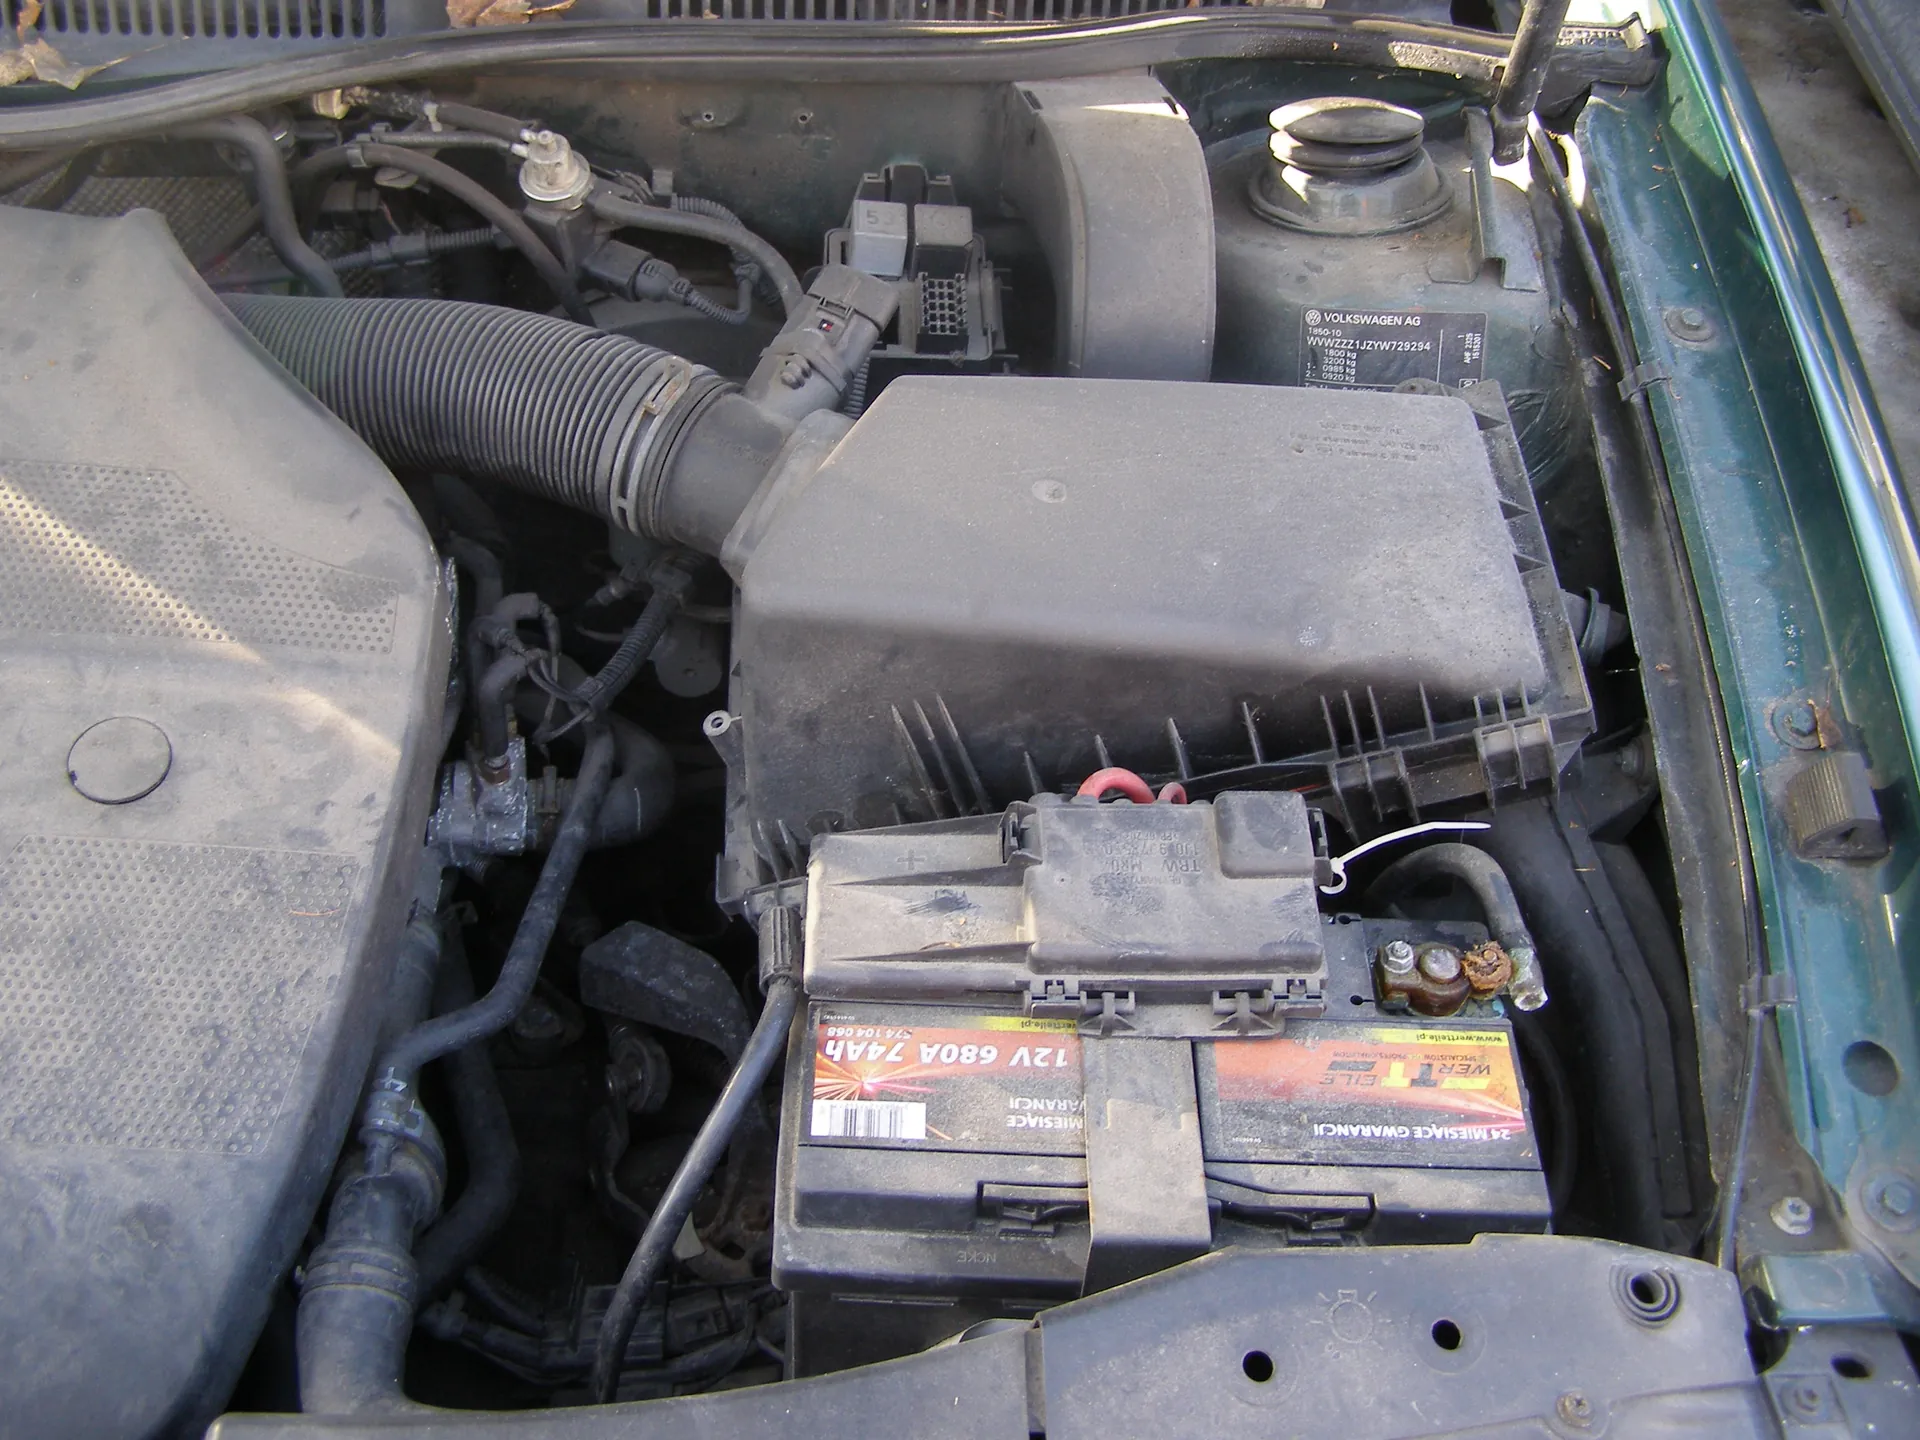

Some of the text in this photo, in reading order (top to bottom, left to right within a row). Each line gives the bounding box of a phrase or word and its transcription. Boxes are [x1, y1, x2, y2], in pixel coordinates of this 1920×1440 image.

[1324, 312, 1403, 326] VOLKSWAGEN
[1404, 315, 1421, 327] AG
[1308, 327, 1342, 337] 1850-10
[1307, 336, 1431, 352] WVWZZZ1JZYW729294
[1325, 349, 1357, 360] 1800 kg
[1323, 357, 1356, 367] 3200 kg
[1322, 365, 1344, 373] 0985
[1346, 366, 1356, 375] kg
[1322, 373, 1344, 381] 0920
[1346, 374, 1355, 383] kg
[1160, 859, 1201, 873] TRW
[827, 1026, 852, 1038] 068
[857, 1027, 881, 1039] 104
[1416, 1033, 1503, 1043] www.wertteile.pl
[825, 1039, 1068, 1068] 12V 680A 74Ah
[1006, 1111, 1084, 1130] MIESIĄCE
[1313, 1122, 1511, 1140] 24 MIESIĄCE GWARANCJI
